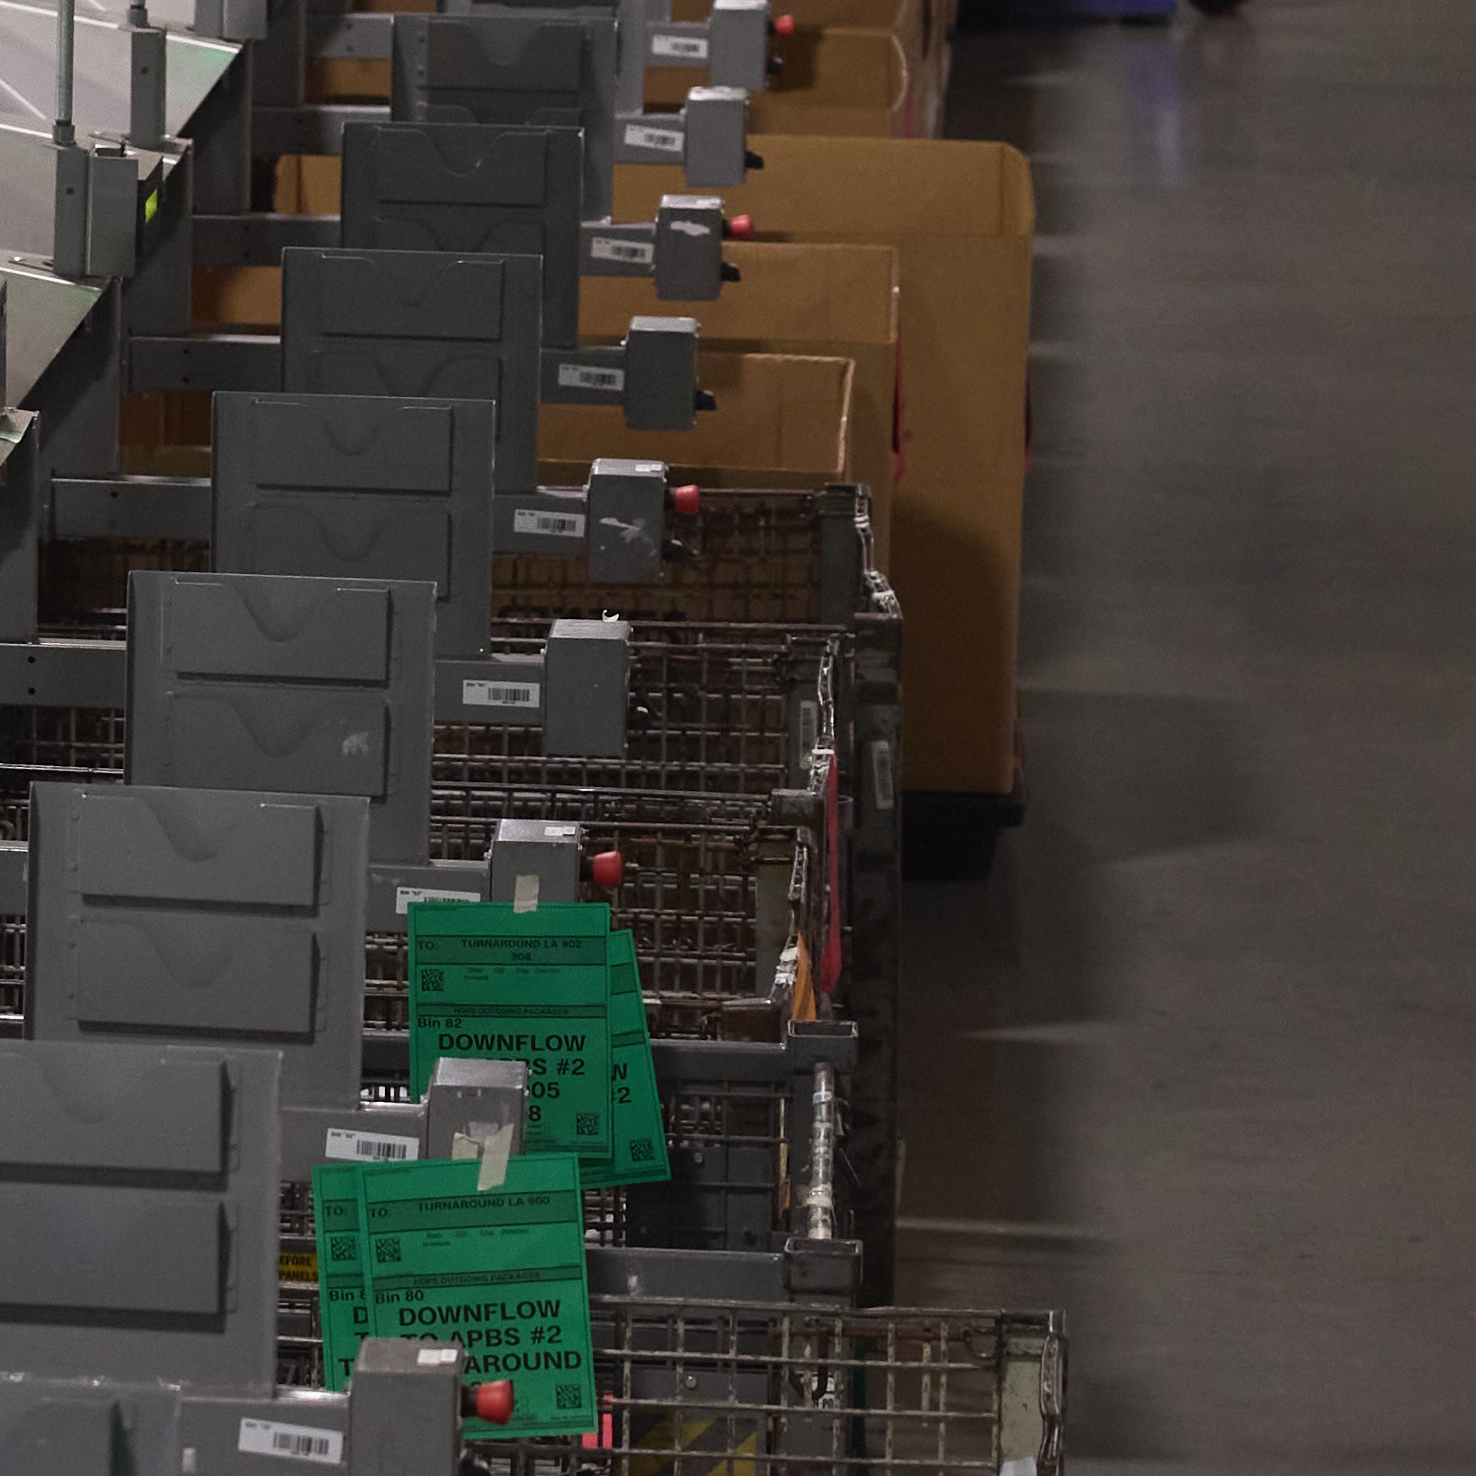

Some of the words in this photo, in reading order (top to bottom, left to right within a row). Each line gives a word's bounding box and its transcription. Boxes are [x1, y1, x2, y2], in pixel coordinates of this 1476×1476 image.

[461, 939, 541, 949] TURNAROUND
[544, 940, 560, 949] LA
[561, 939, 582, 949] 902
[523, 1007, 569, 1016] PACKAGES
[418, 1017, 443, 1029] Bin
[445, 1017, 462, 1029] 82
[438, 1033, 586, 1052] DOWNFLOW
[556, 1058, 585, 1076] #2
[527, 1081, 560, 1099] 05
[325, 1206, 347, 1217] TO:
[369, 1207, 392, 1218] TO:
[418, 1198, 505, 1213] TURNAROUND
[508, 1197, 524, 1206] LA
[279, 1254, 312, 1266] EFORE
[490, 1271, 540, 1282] PACKAGES
[329, 1290, 355, 1302] Bin
[375, 1292, 400, 1304] Bin
[405, 1289, 424, 1301] 80
[398, 1299, 561, 1326] DOWNFLOW
[530, 1325, 562, 1344] #2
[464, 1351, 582, 1374] AROUND
